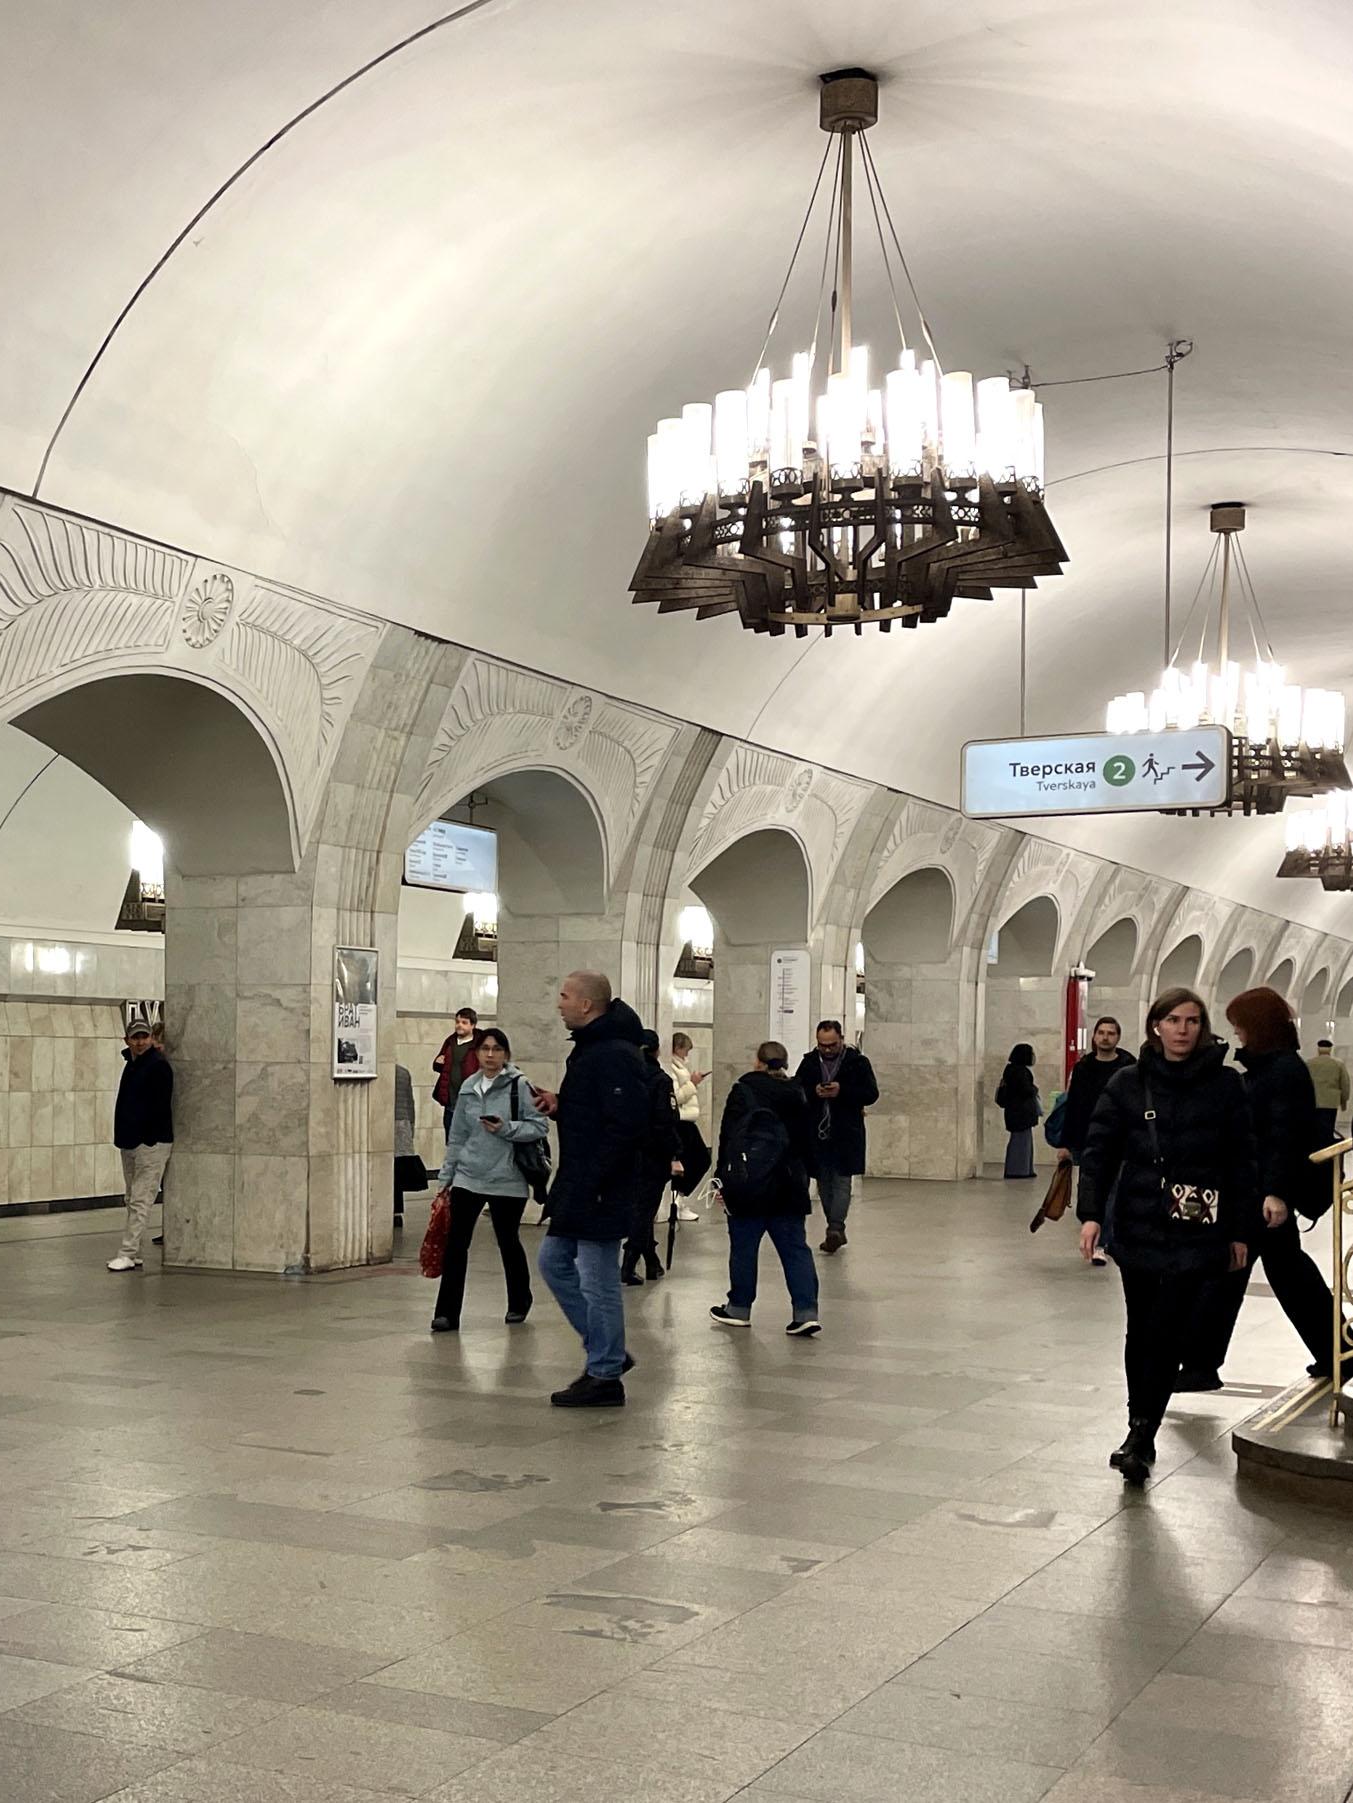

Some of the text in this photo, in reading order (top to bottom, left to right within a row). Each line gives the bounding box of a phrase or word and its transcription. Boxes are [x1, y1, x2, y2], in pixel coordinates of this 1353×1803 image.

[1009, 762, 1126, 779] Тверская 2
[1037, 779, 1096, 791] Tverskaya
[338, 1015, 360, 1028] ИВАН
